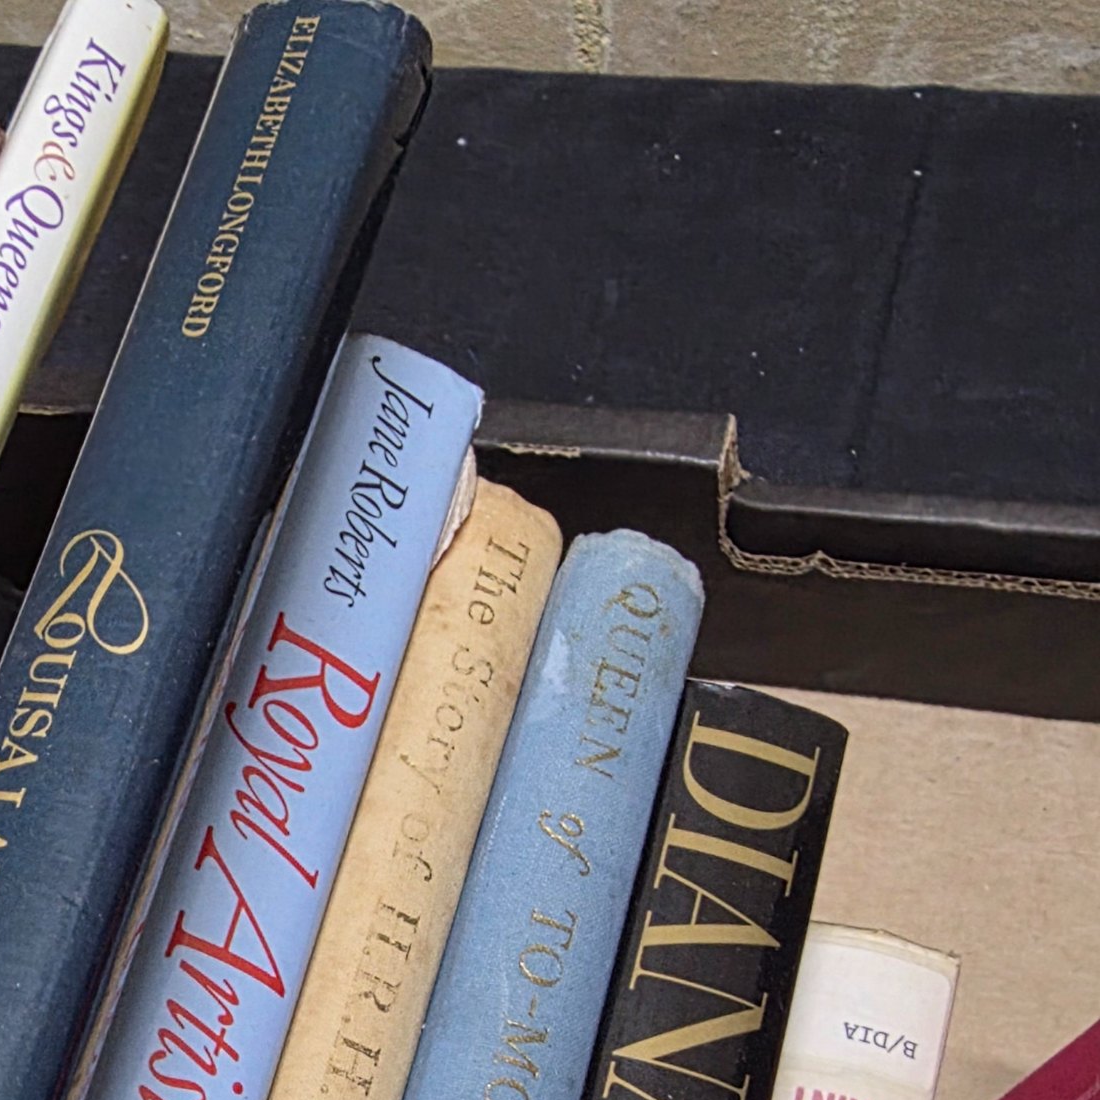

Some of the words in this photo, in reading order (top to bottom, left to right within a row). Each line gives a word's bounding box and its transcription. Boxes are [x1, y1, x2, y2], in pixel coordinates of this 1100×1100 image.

[44, 38, 126, 148] Kings
[240, 15, 321, 171] ELIZABETH
[181, 173, 264, 338] LONGFORD
[368, 355, 434, 467] Jane
[324, 459, 409, 608] Roberts
[468, 537, 532, 625] The
[226, 612, 382, 891] Royal
[400, 645, 495, 796] Story
[575, 583, 660, 780] QUEEN
[538, 809, 590, 877] of
[843, 1021, 918, 1060] B/DIA
